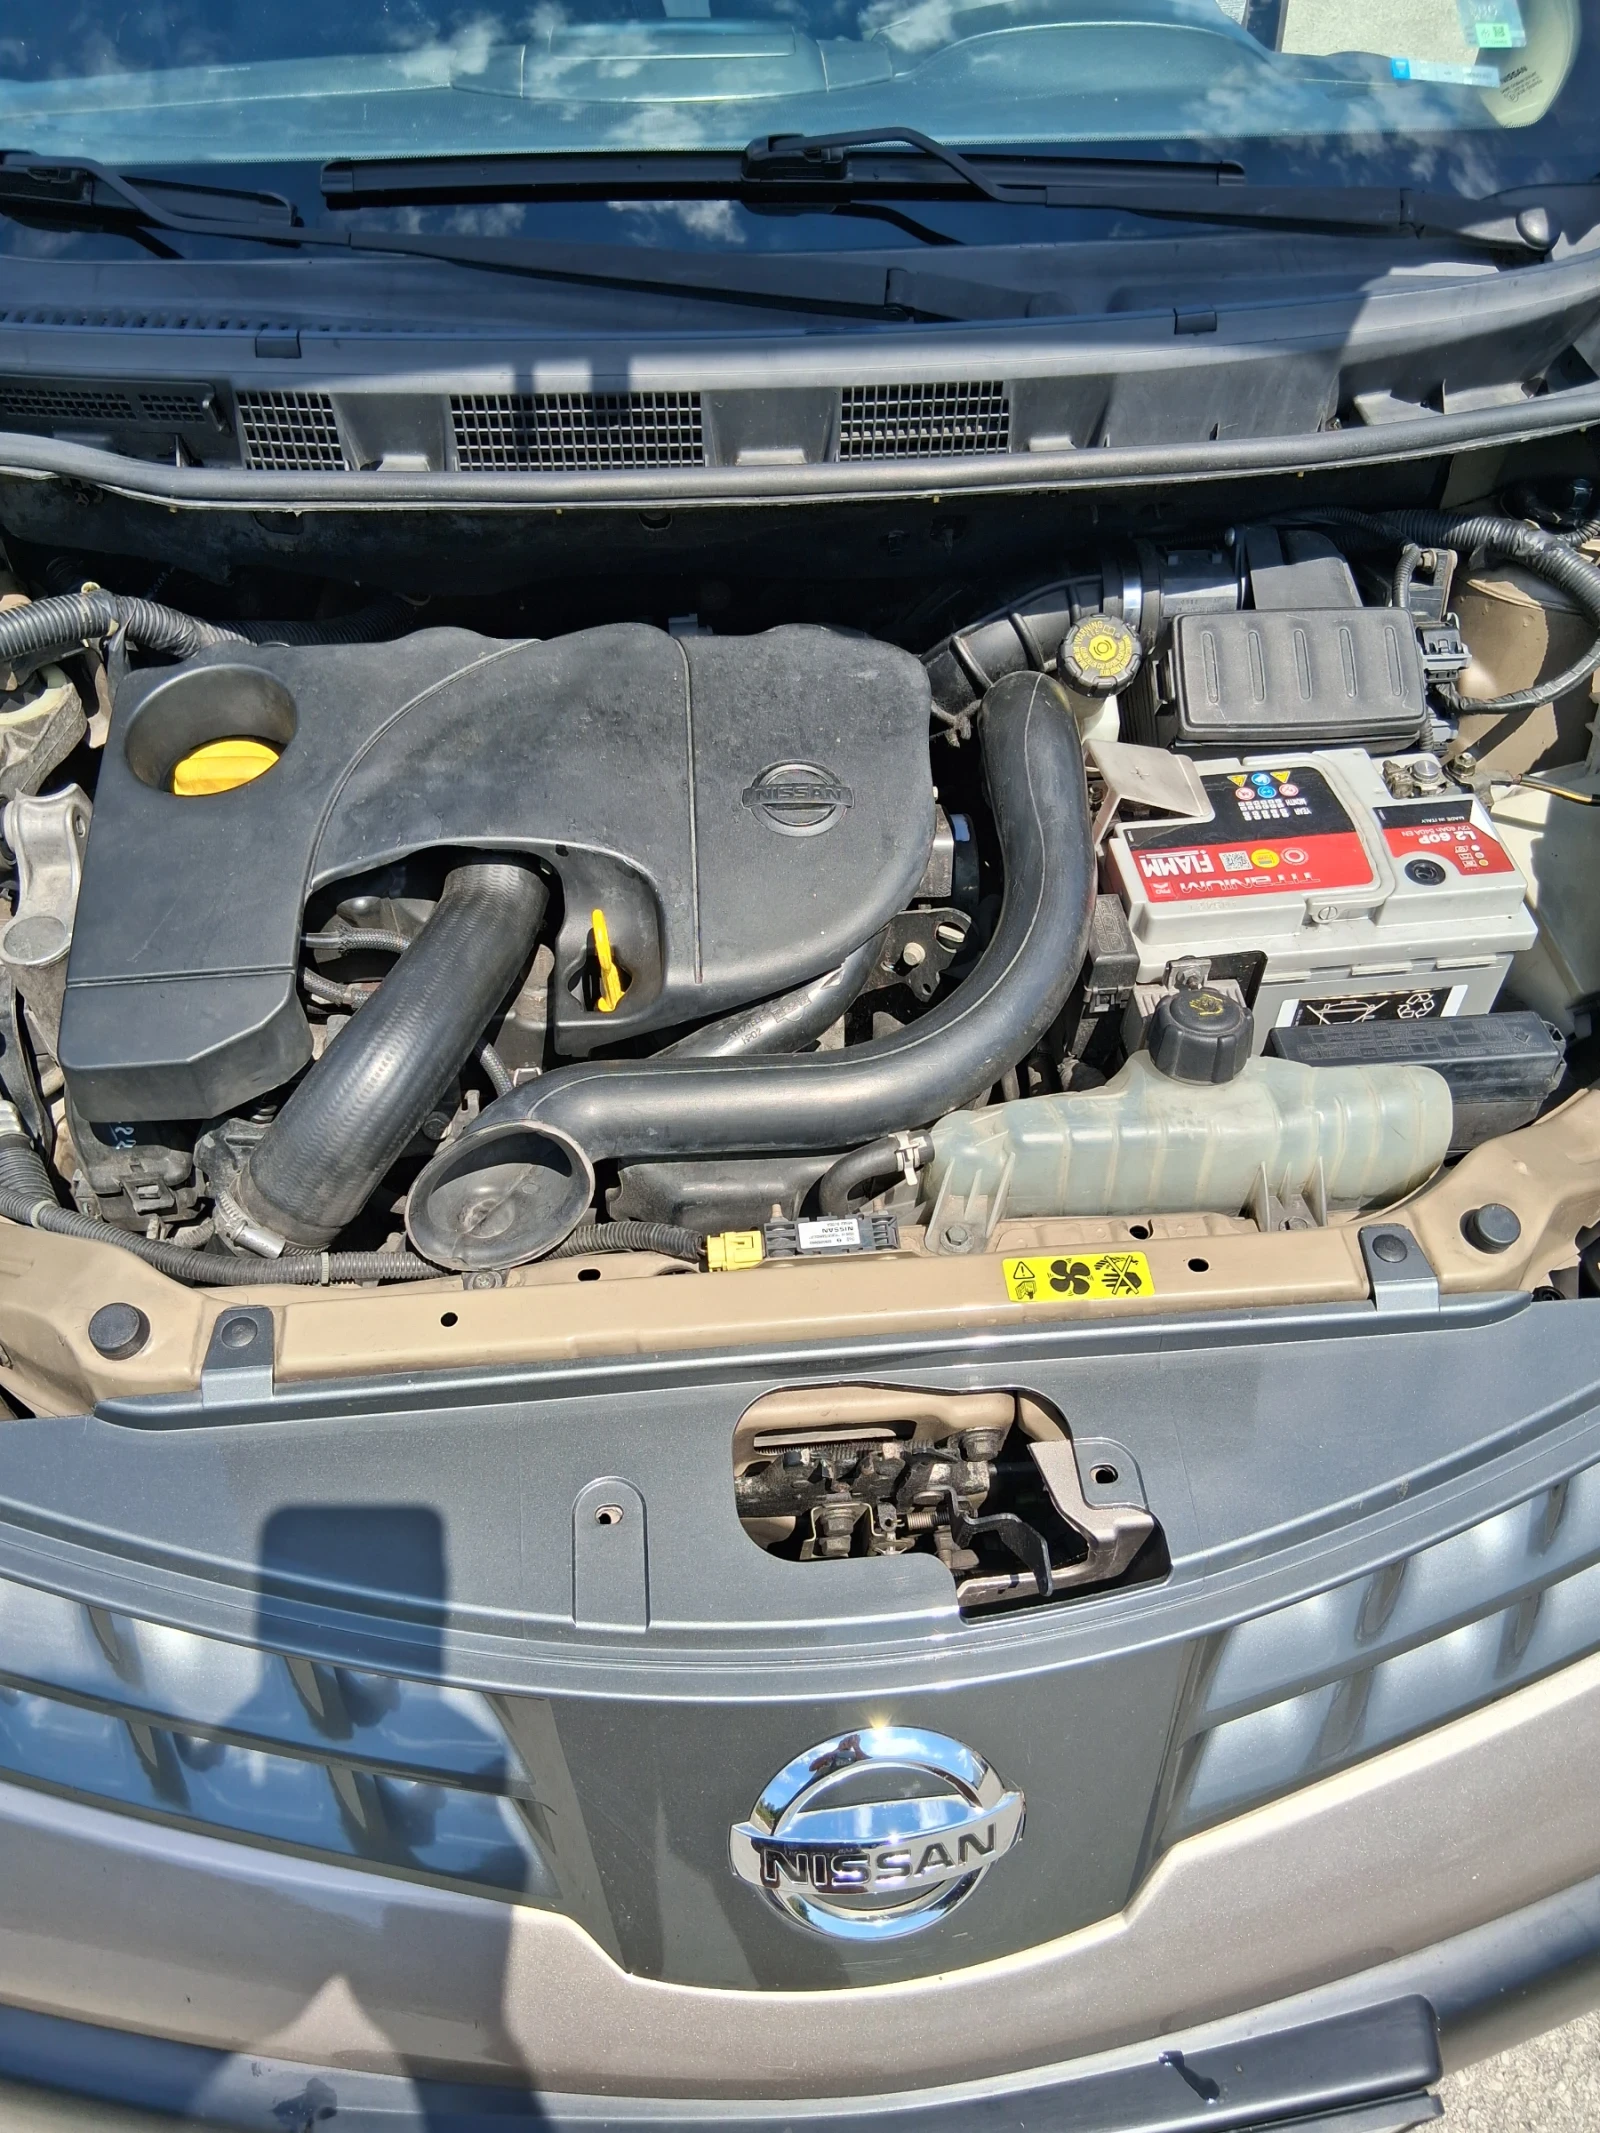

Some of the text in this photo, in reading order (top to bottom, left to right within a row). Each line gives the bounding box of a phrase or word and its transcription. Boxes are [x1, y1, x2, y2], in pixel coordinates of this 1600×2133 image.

[1074, 620, 1103, 644] WARNING
[754, 785, 842, 801] NISSAN
[1294, 806, 1312, 816] YEAR
[1418, 830, 1477, 845] L2 60P
[1139, 853, 1214, 878] FIAMM
[1155, 886, 1171, 894] PRO
[763, 1821, 998, 1887] NISSAN
